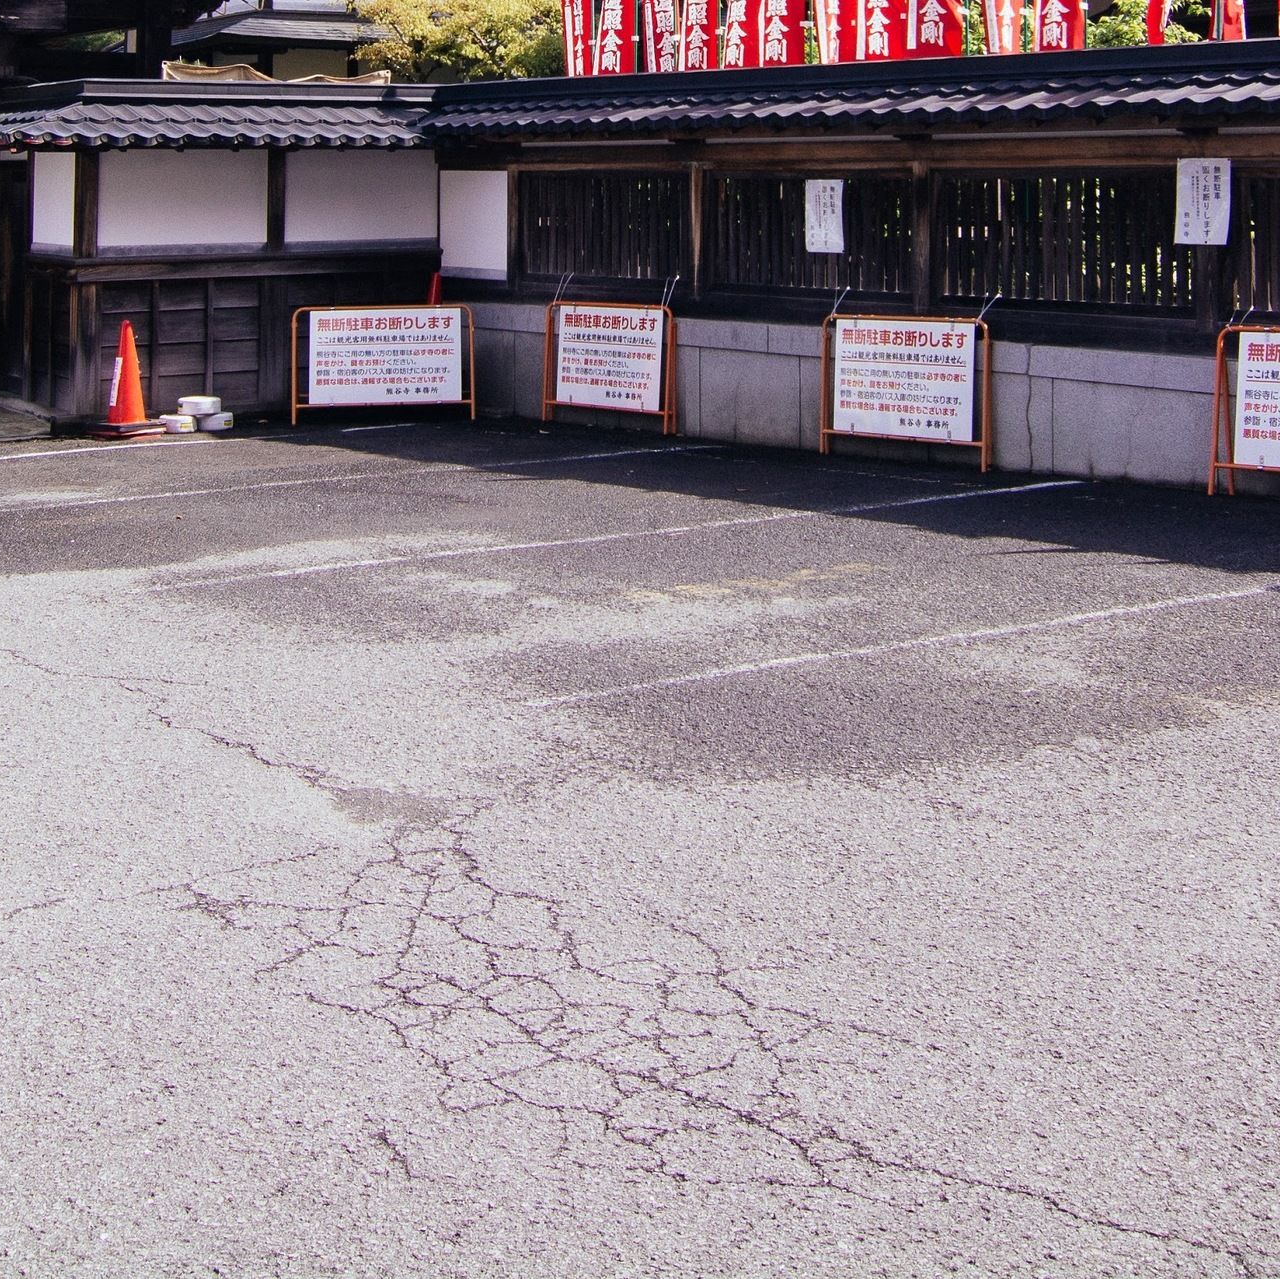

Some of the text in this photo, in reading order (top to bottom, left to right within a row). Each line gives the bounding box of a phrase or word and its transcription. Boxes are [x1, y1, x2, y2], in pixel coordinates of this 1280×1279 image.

[317, 316, 454, 332] 無断駐車お断りします
[564, 313, 657, 331] 無断駐車お断りします
[841, 328, 967, 349] 無断駐車お断りします
